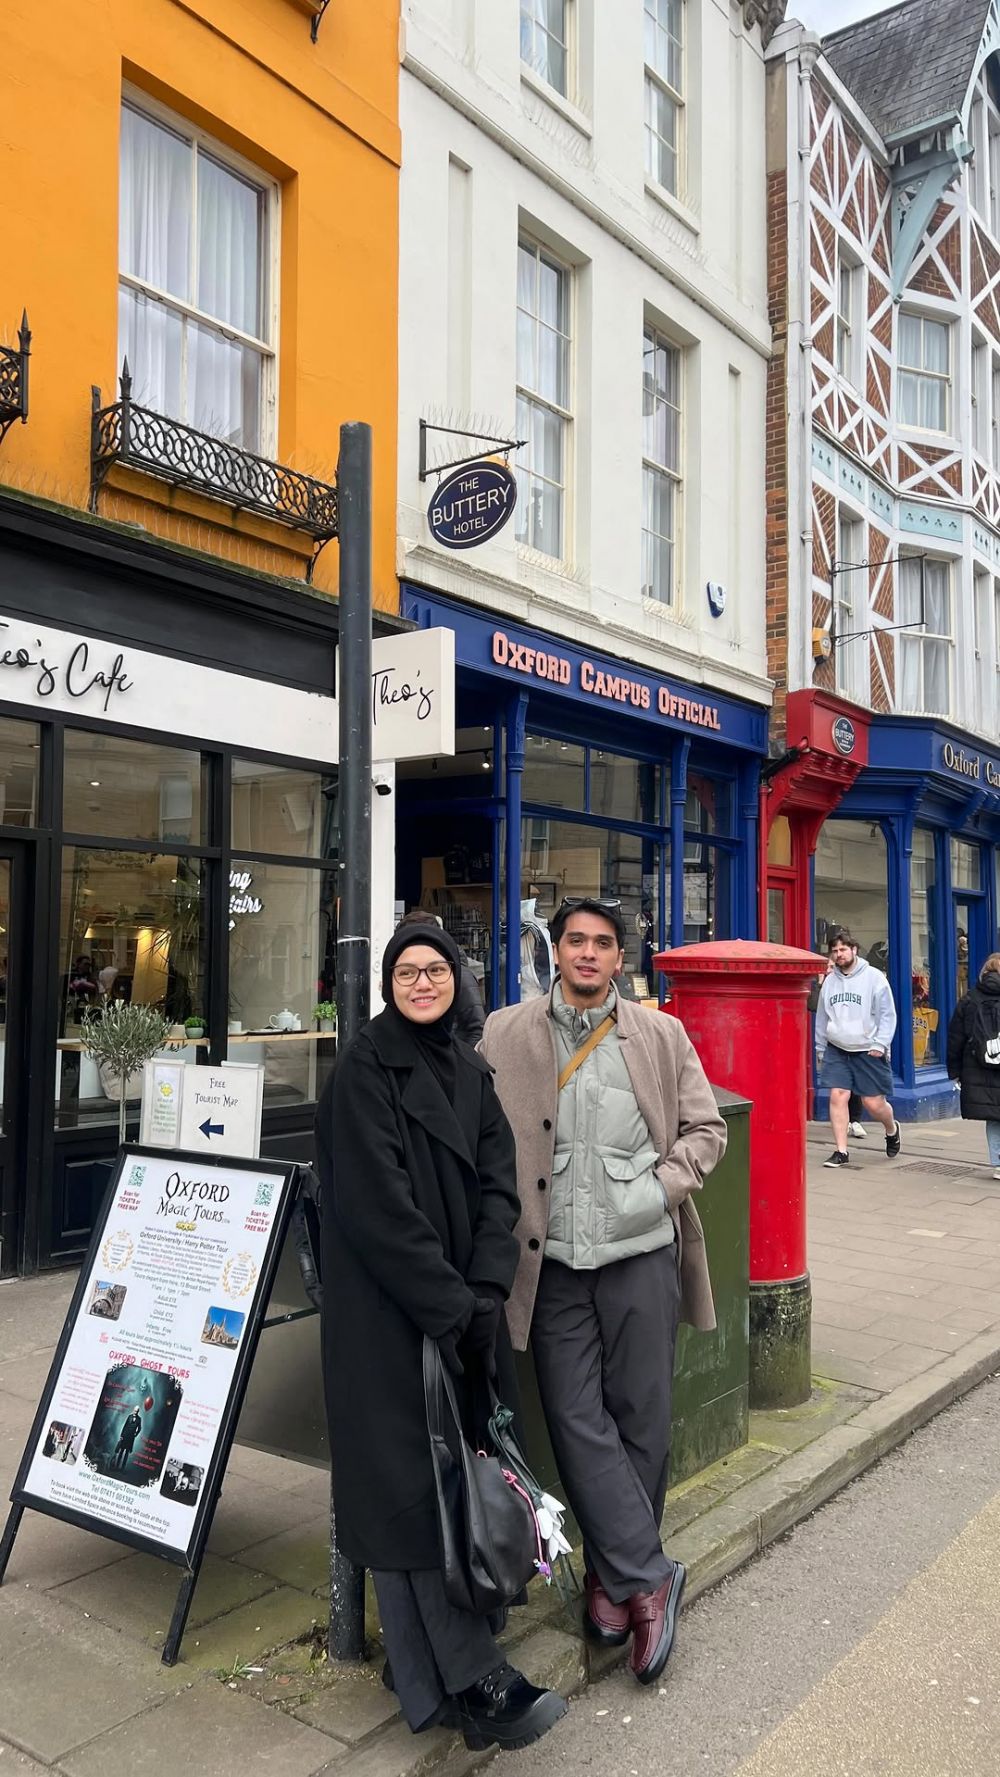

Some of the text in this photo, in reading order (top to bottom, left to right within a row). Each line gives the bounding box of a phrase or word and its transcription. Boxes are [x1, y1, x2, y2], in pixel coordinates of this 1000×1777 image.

[458, 476, 479, 494] THE
[432, 483, 510, 526] BUTTERY
[454, 516, 488, 536] HOTEL
[0, 622, 134, 712] eo's Cafe
[492, 630, 720, 730] OXFORD CAMPUS OFFICIAL
[372, 668, 434, 726] Theo's
[944, 742, 980, 780] Oxford
[228, 894, 262, 914] tairs
[830, 992, 862, 1006] CHILDISH
[166, 1172, 230, 1202] OXFORD
[156, 1235, 181, 1244] University
[108, 1350, 136, 1364] OXFORD
[139, 1358, 163, 1371] GHOST
[166, 1365, 190, 1378] TOURS
